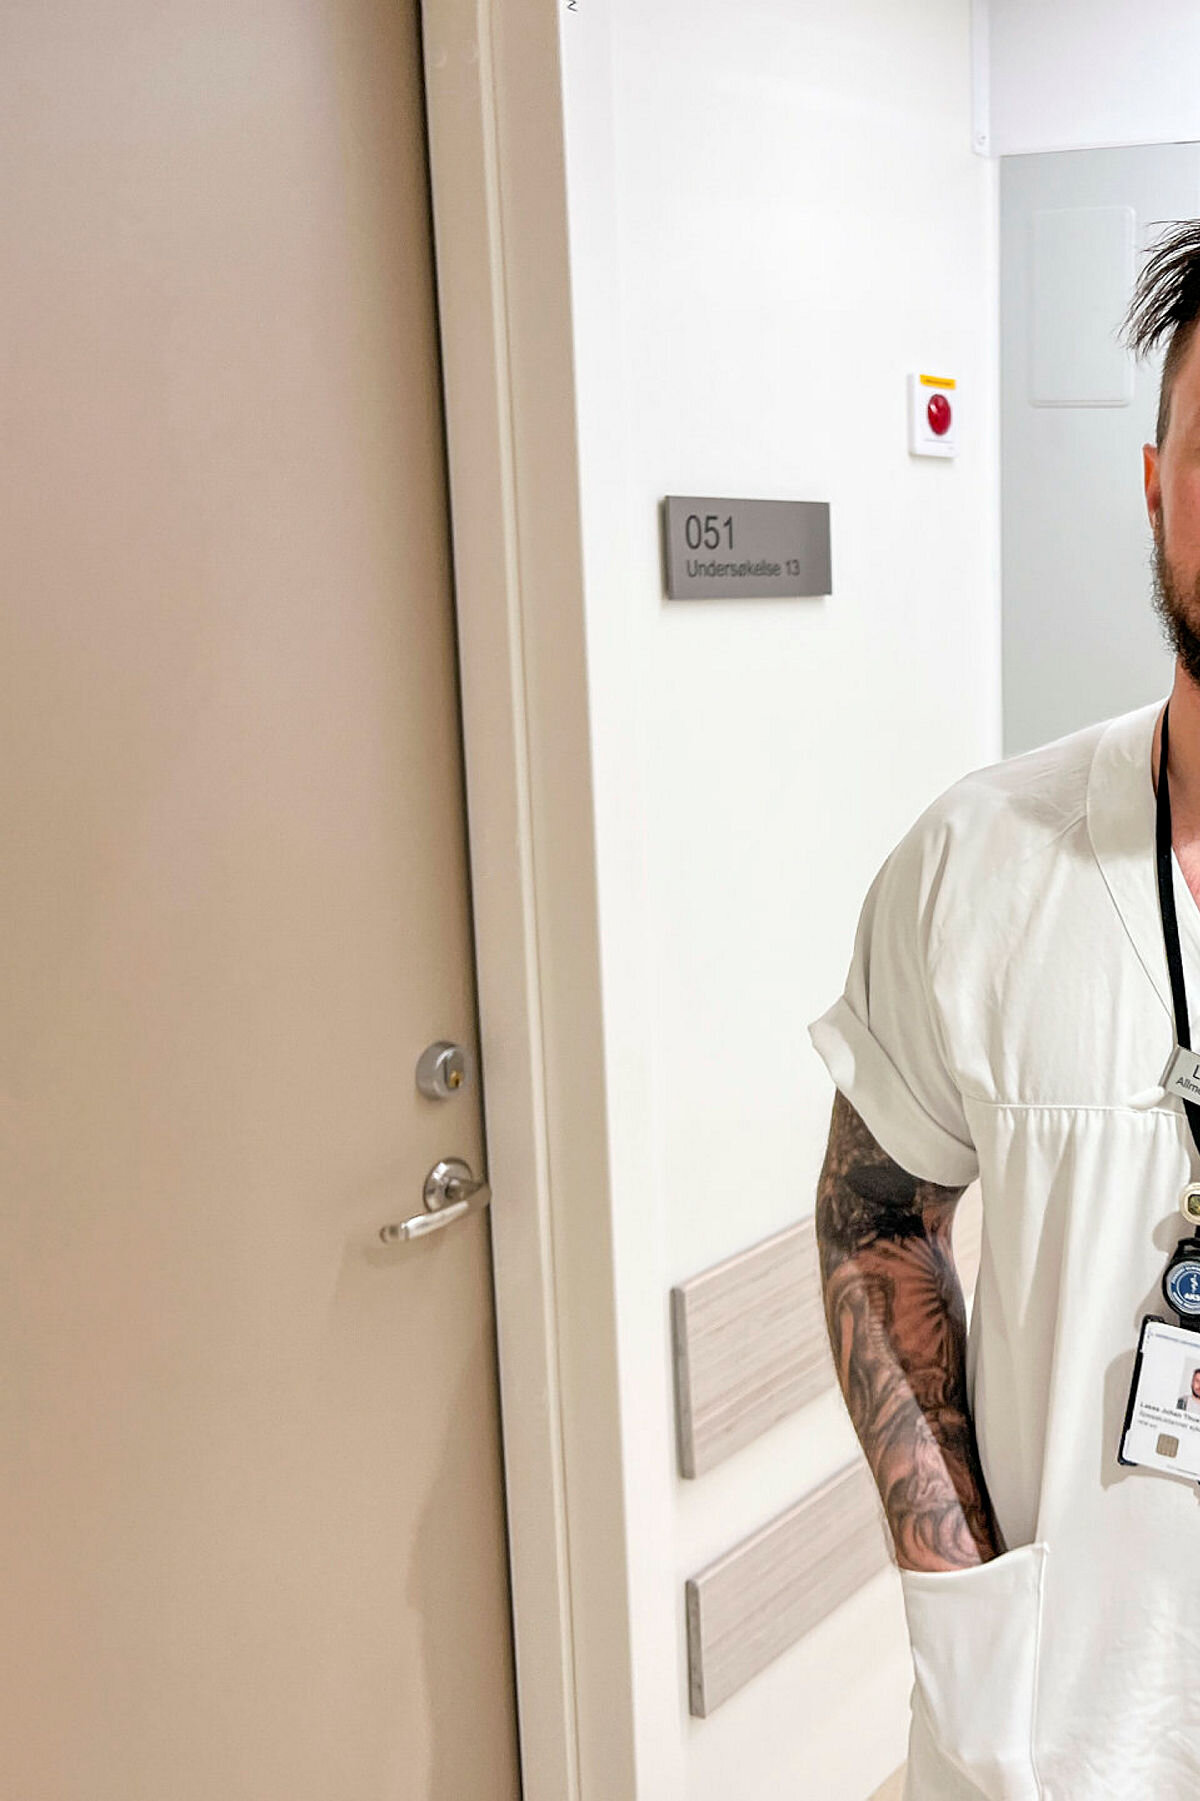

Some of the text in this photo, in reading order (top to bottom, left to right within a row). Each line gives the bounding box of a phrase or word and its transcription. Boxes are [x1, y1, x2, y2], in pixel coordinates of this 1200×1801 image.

[685, 515, 734, 550] 051
[687, 559, 800, 578] Undersøkelse 13
